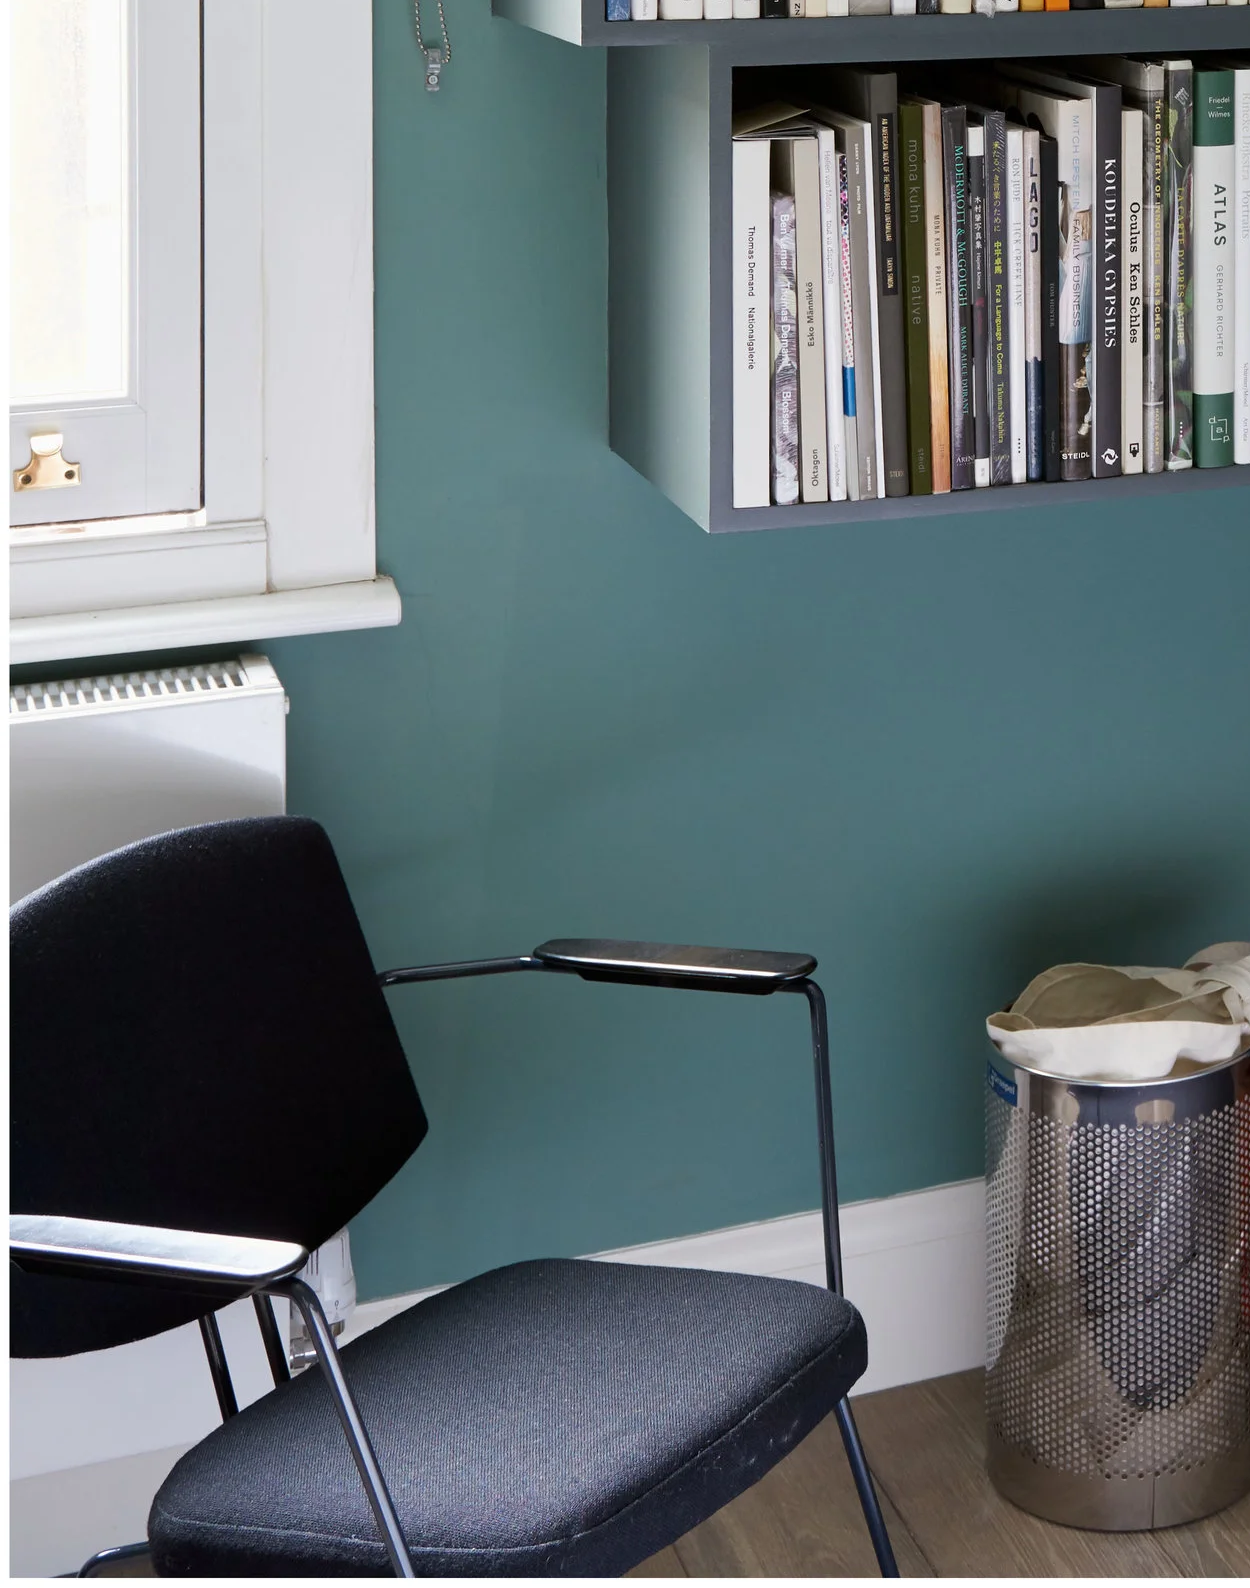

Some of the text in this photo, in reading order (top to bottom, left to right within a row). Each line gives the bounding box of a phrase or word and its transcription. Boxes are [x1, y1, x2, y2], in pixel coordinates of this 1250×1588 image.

[1104, 159, 1118, 348] KOUDELKA GYPSIES
[1129, 202, 1141, 344] Oculus Ken Schles
[1213, 184, 1227, 358] ATLAS GERHARD RICHTER
